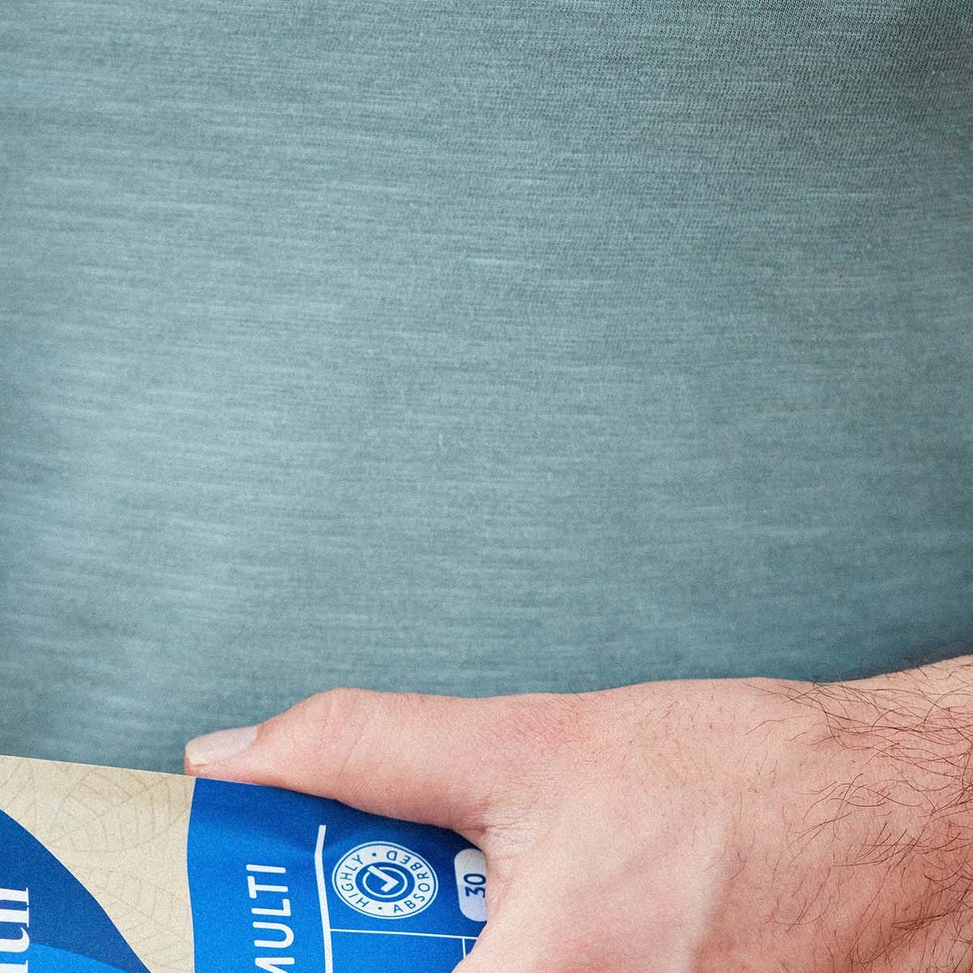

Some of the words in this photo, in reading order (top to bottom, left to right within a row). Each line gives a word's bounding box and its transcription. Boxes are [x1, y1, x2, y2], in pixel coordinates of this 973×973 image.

[340, 854, 370, 908] HIGHLY
[386, 850, 431, 914] ABSORBED
[463, 873, 486, 898] 30
